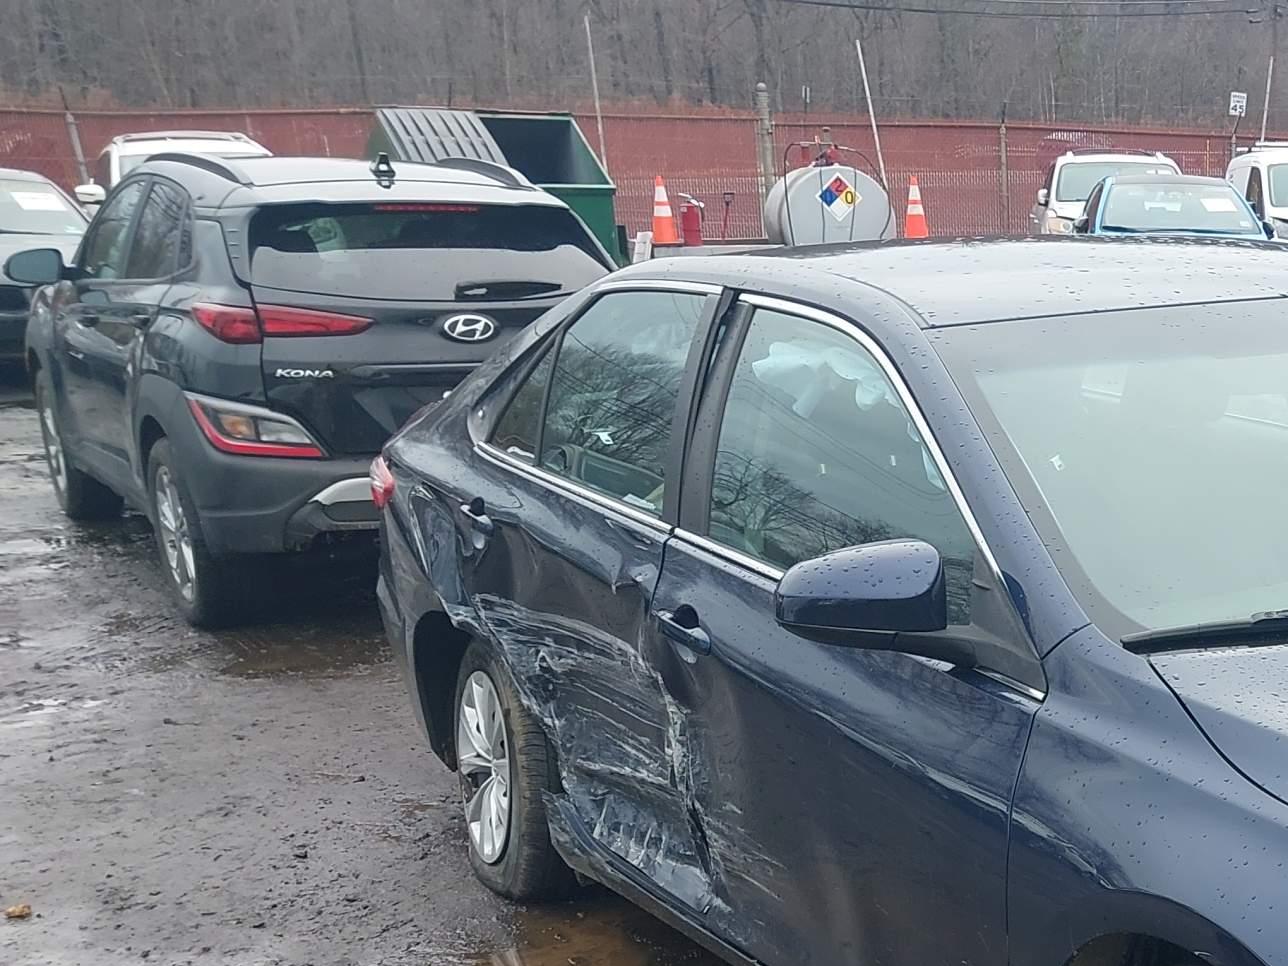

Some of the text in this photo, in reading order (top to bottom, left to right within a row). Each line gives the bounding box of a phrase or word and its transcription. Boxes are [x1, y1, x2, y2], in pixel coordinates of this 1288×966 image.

[1231, 104, 1244, 113] 45
[835, 177, 843, 192] 2
[845, 191, 853, 204] 0
[275, 368, 334, 378] KONA
